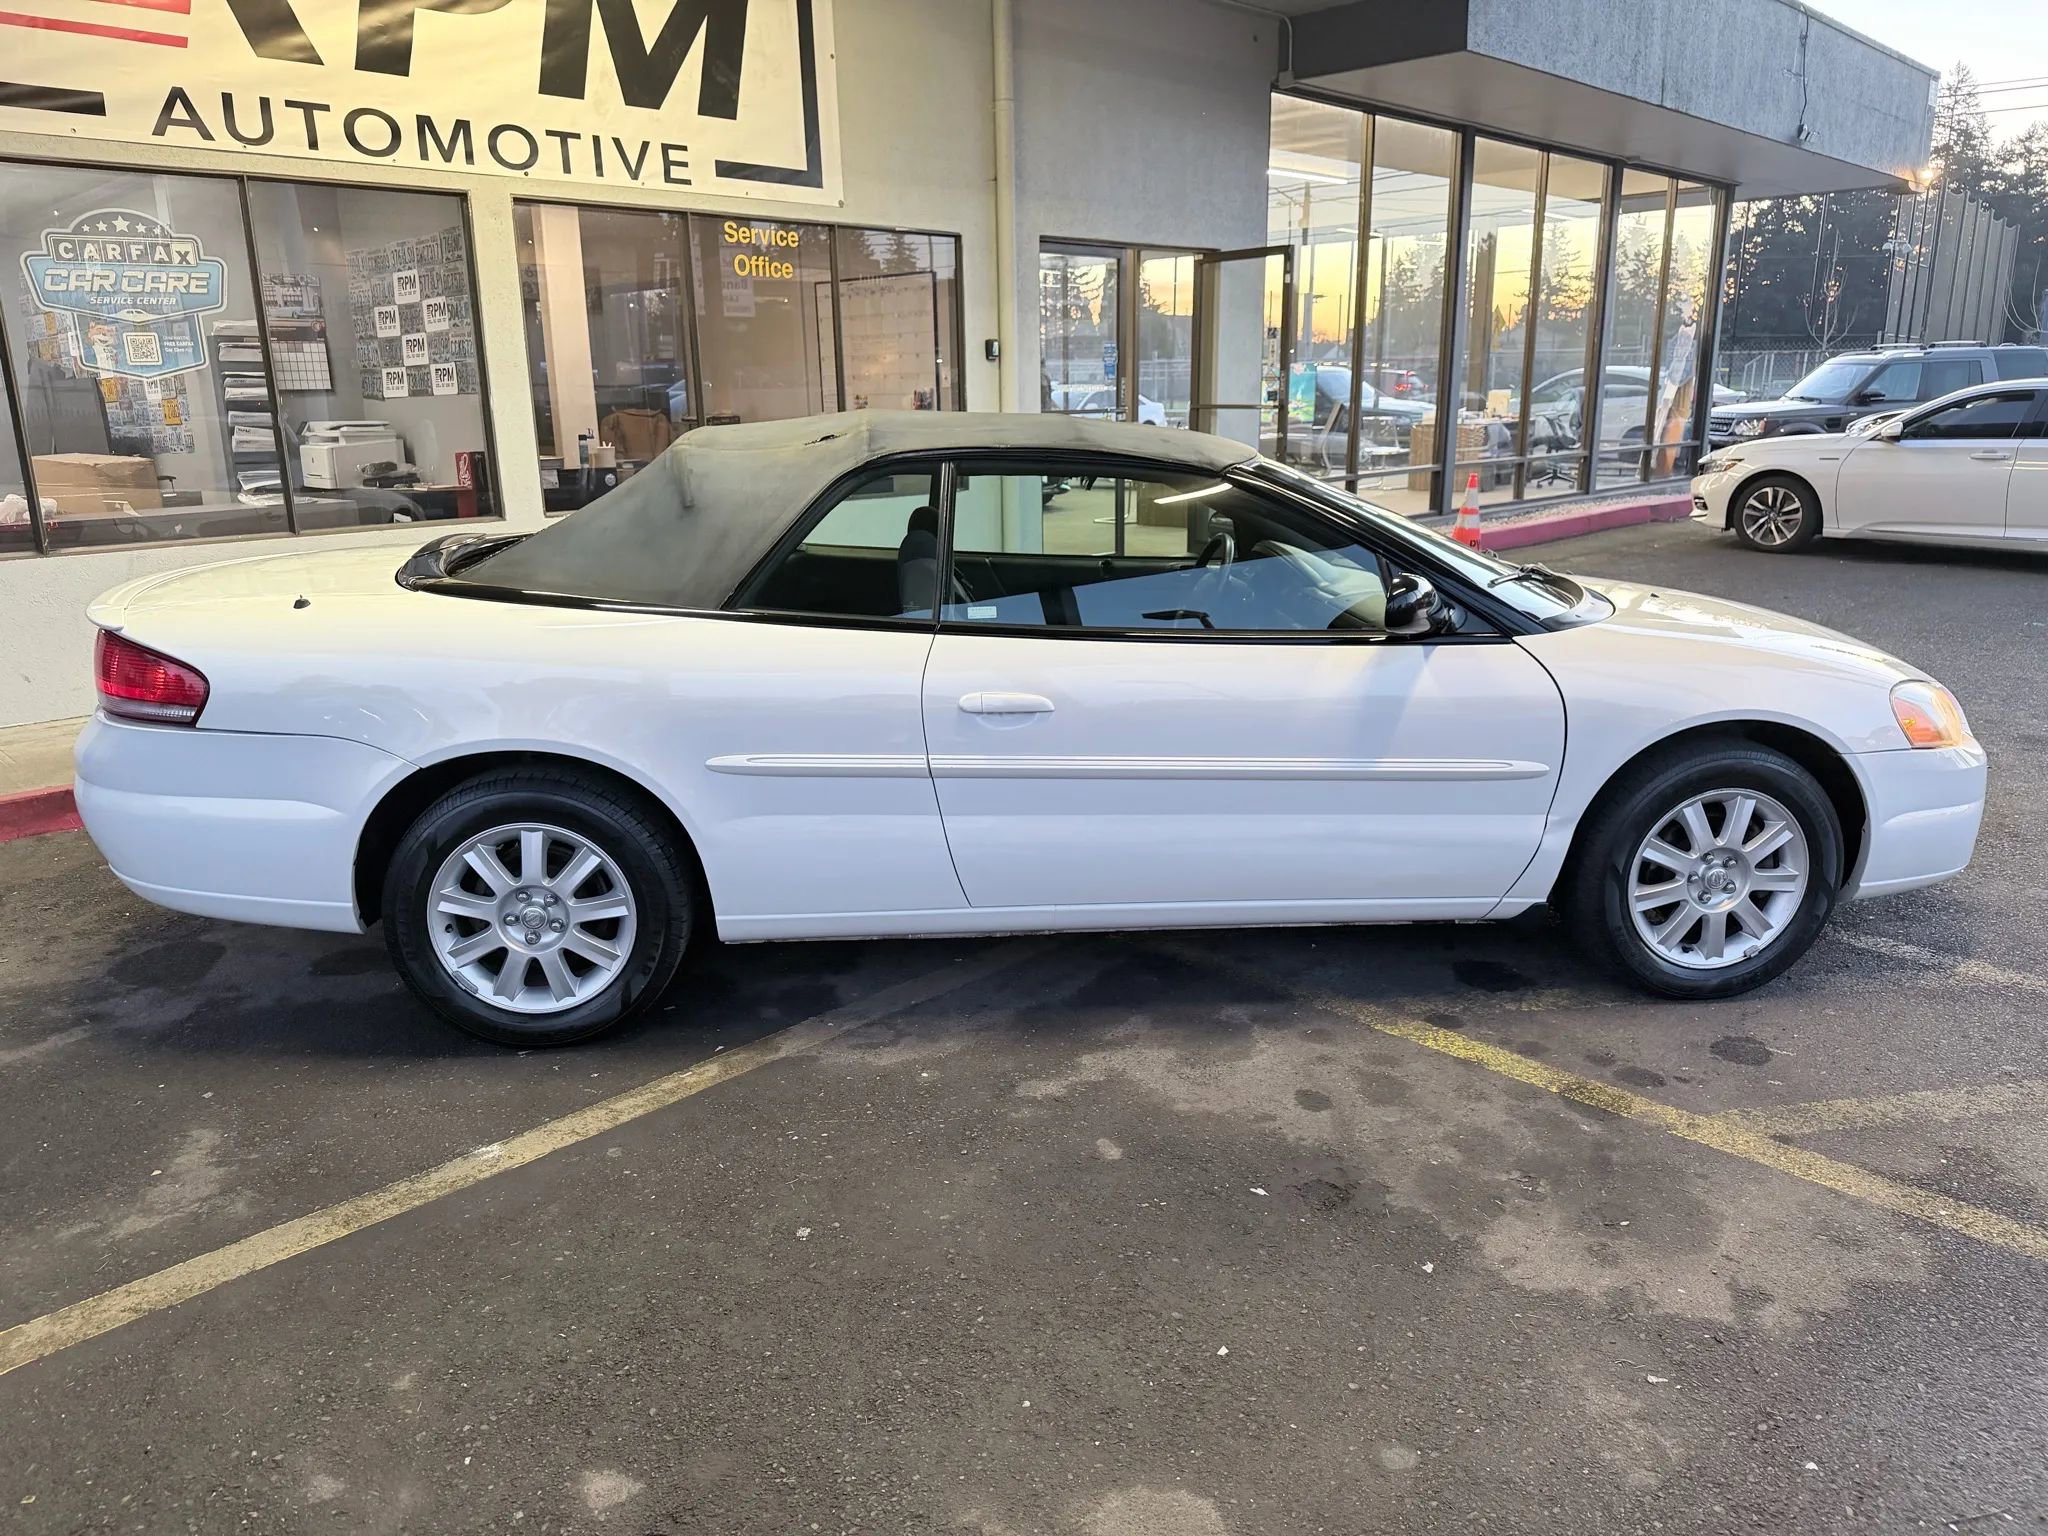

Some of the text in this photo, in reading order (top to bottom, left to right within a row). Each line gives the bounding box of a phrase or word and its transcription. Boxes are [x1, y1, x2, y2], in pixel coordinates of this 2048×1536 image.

[152, 85, 693, 185] AUTOMOTIVE
[723, 220, 800, 248] Service
[57, 241, 191, 265] CARFAX
[733, 253, 794, 279] Office
[43, 267, 211, 294] CAR CARE
[397, 273, 417, 291] RPM
[90, 296, 177, 306] SERVICE CENTER
[427, 301, 447, 319] RPM
[377, 309, 397, 325] RPM
[405, 337, 425, 354] RPM
[386, 370, 405, 386] RPM
[435, 366, 455, 383] RPM
